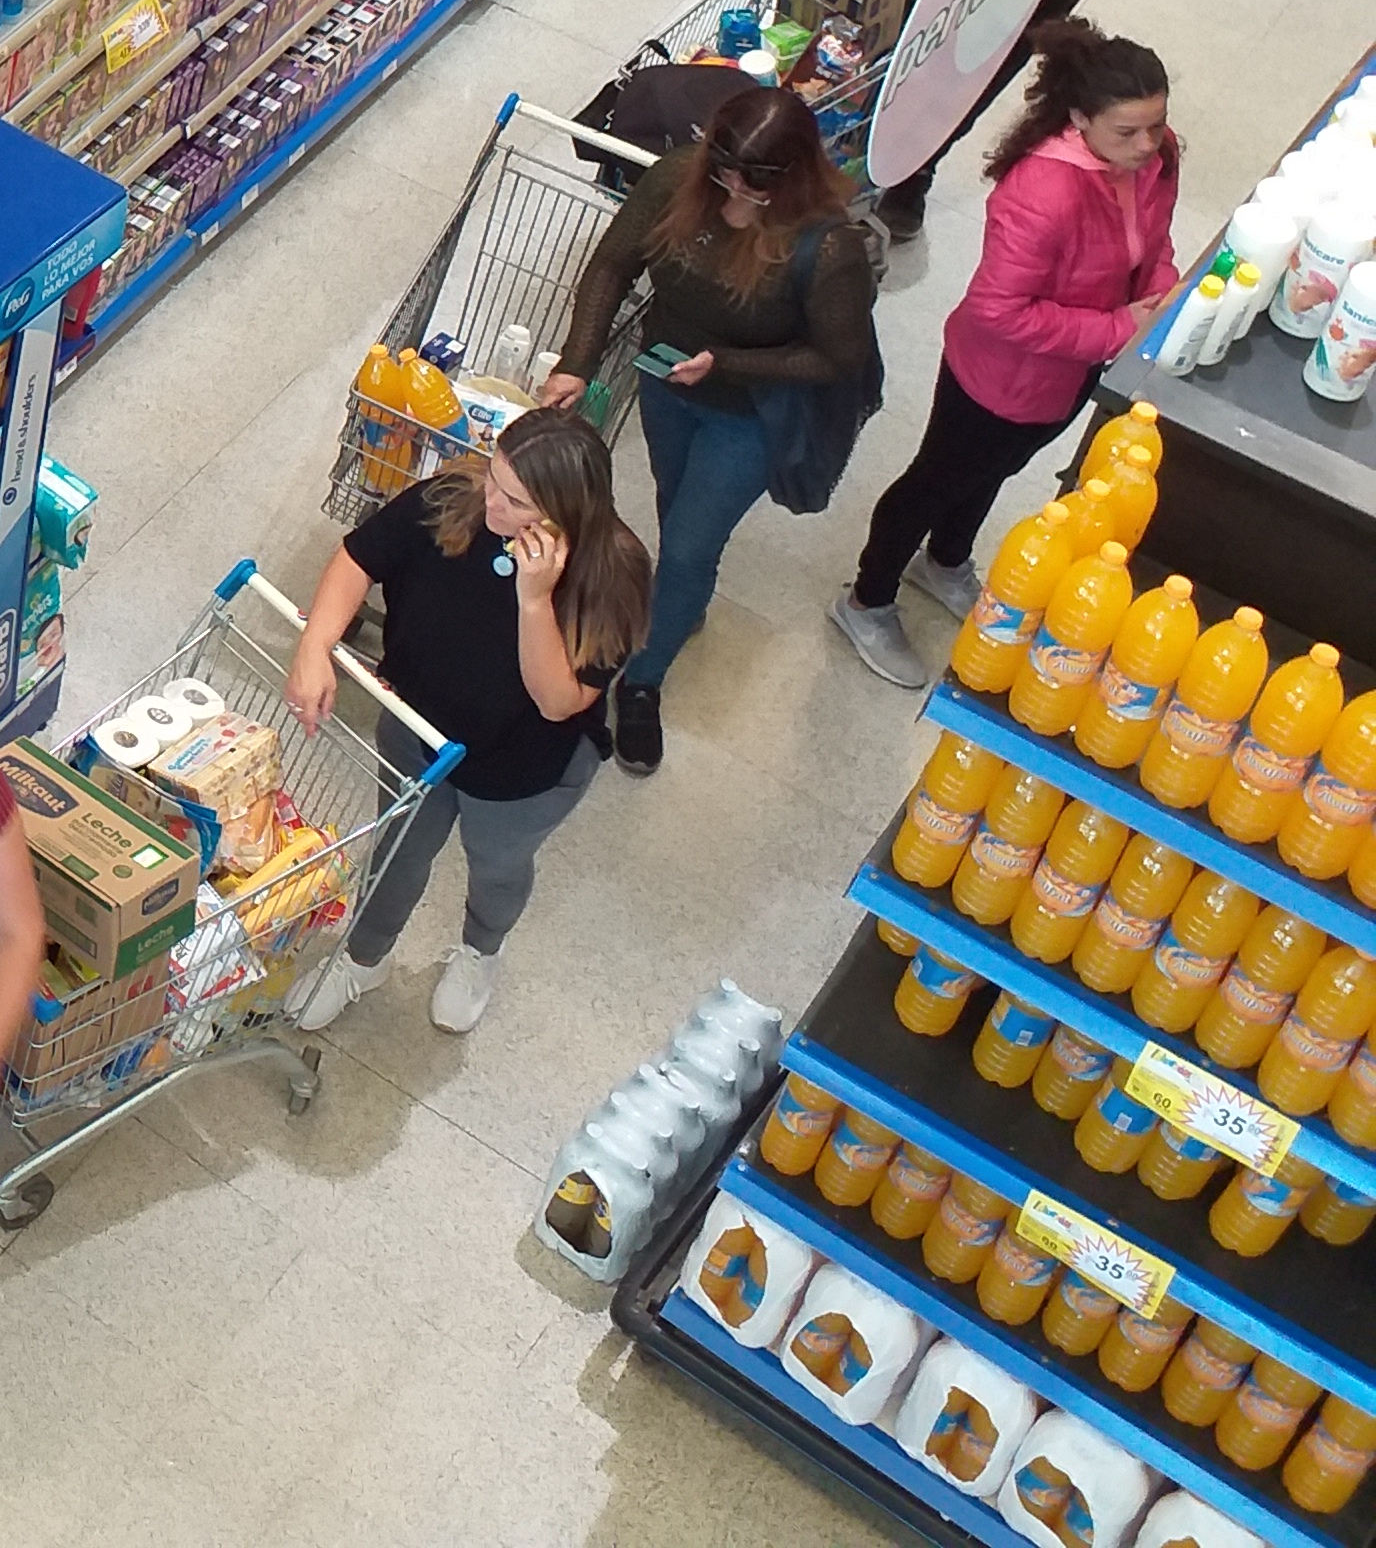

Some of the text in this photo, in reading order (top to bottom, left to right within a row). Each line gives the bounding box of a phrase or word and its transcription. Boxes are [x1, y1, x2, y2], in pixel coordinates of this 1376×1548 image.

[43, 239, 96, 286] LO MEJOR
[47, 239, 79, 268] TODO
[41, 253, 95, 301] PARA VOS
[81, 812, 134, 850] Leche
[1212, 1107, 1248, 1136] 35
[1093, 1255, 1125, 1280] 35
